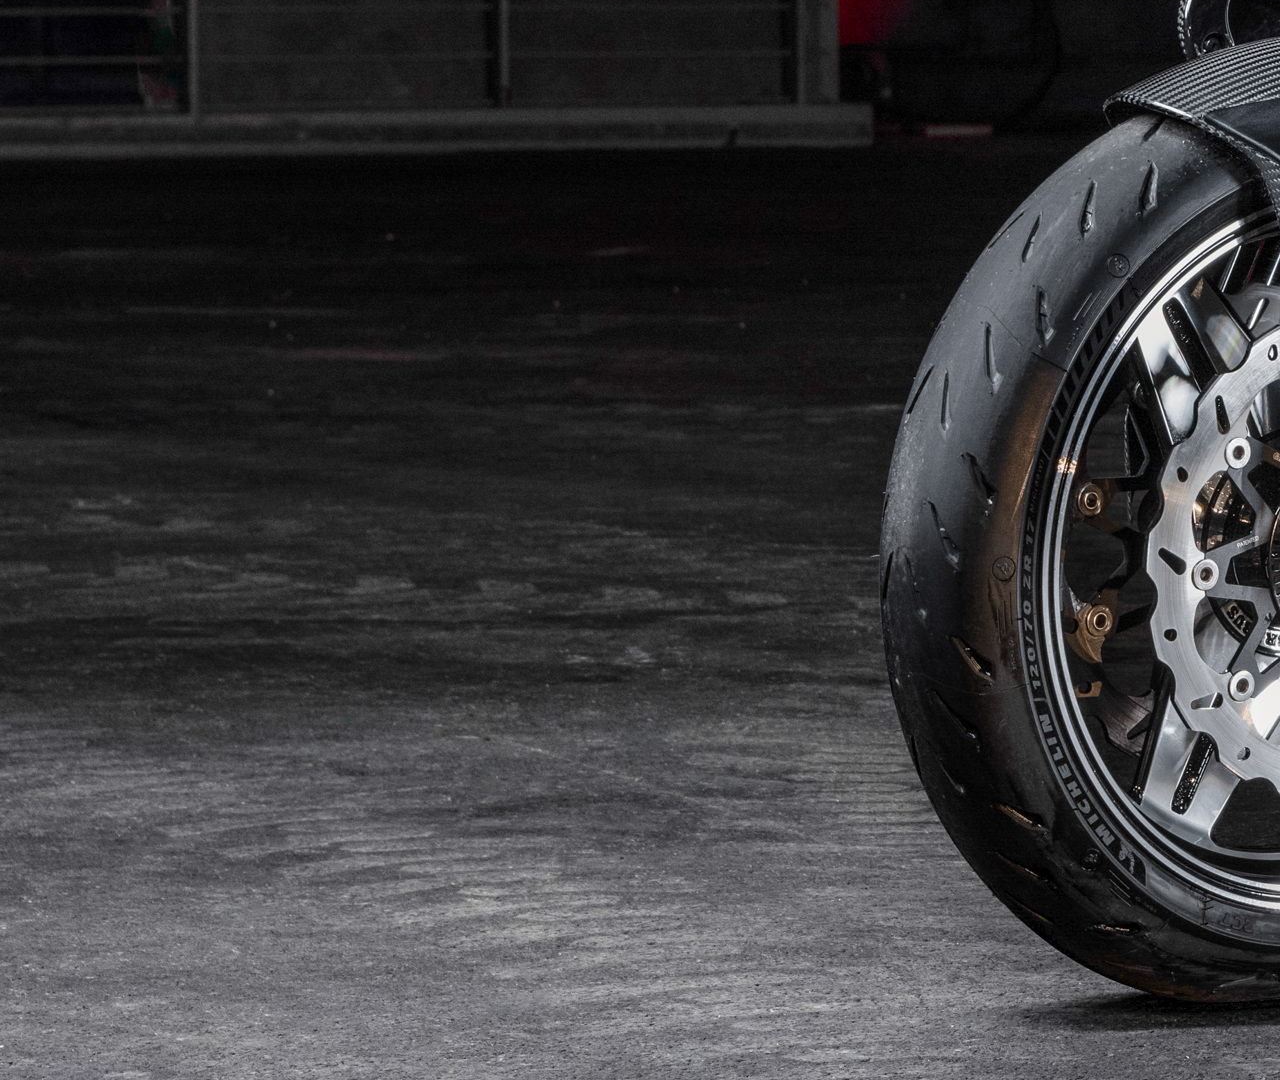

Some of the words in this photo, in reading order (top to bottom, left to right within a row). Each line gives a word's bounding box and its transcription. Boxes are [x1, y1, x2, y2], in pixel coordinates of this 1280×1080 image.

[1024, 518, 1035, 546] 17
[1023, 554, 1033, 584] ZR
[1023, 602, 1041, 690] 120/70
[1038, 713, 1115, 847] MICHELIN
